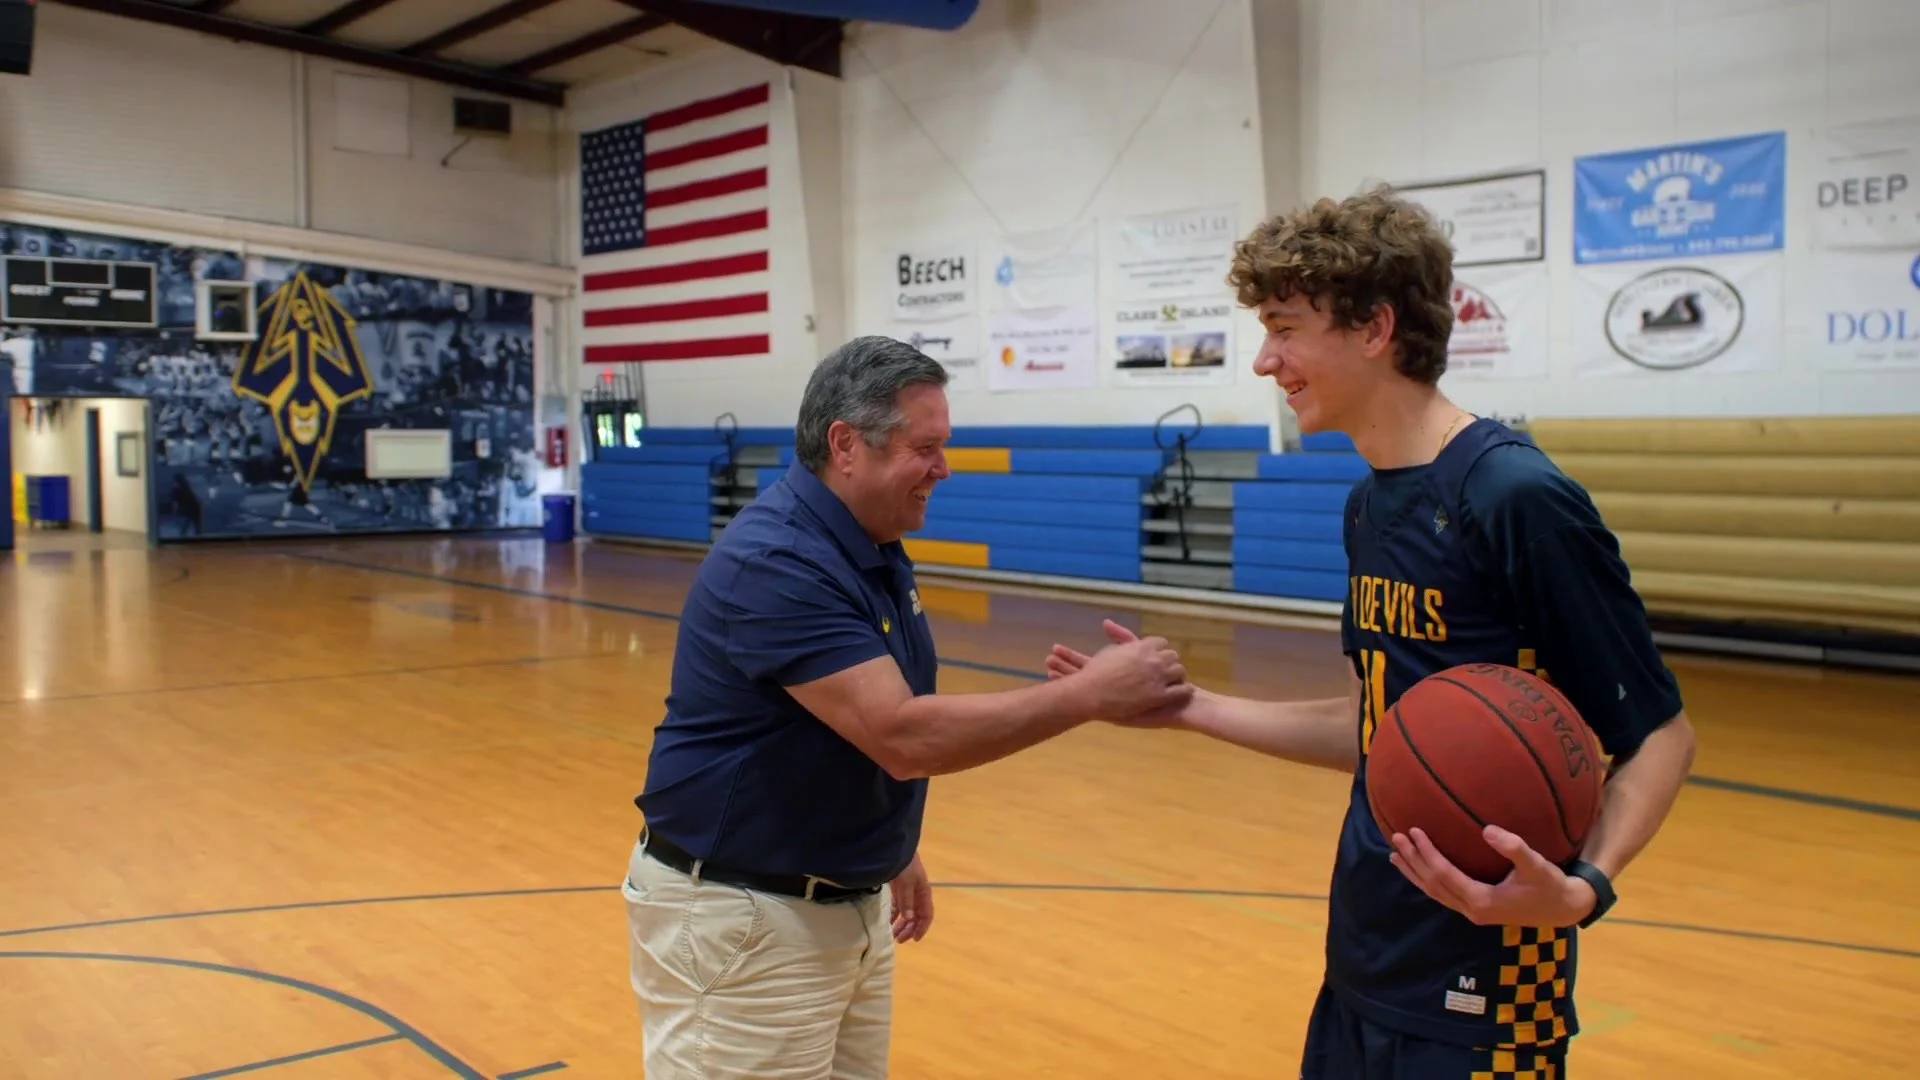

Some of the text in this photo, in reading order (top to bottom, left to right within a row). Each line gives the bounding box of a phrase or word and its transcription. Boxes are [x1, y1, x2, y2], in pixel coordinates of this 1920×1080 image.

[1626, 152, 1723, 192] MARTIN'S
[1818, 173, 1909, 208] DEEP
[898, 254, 966, 286] BEECH
[1360, 575, 1447, 642] DEVILS
[1459, 975, 1476, 991] M
